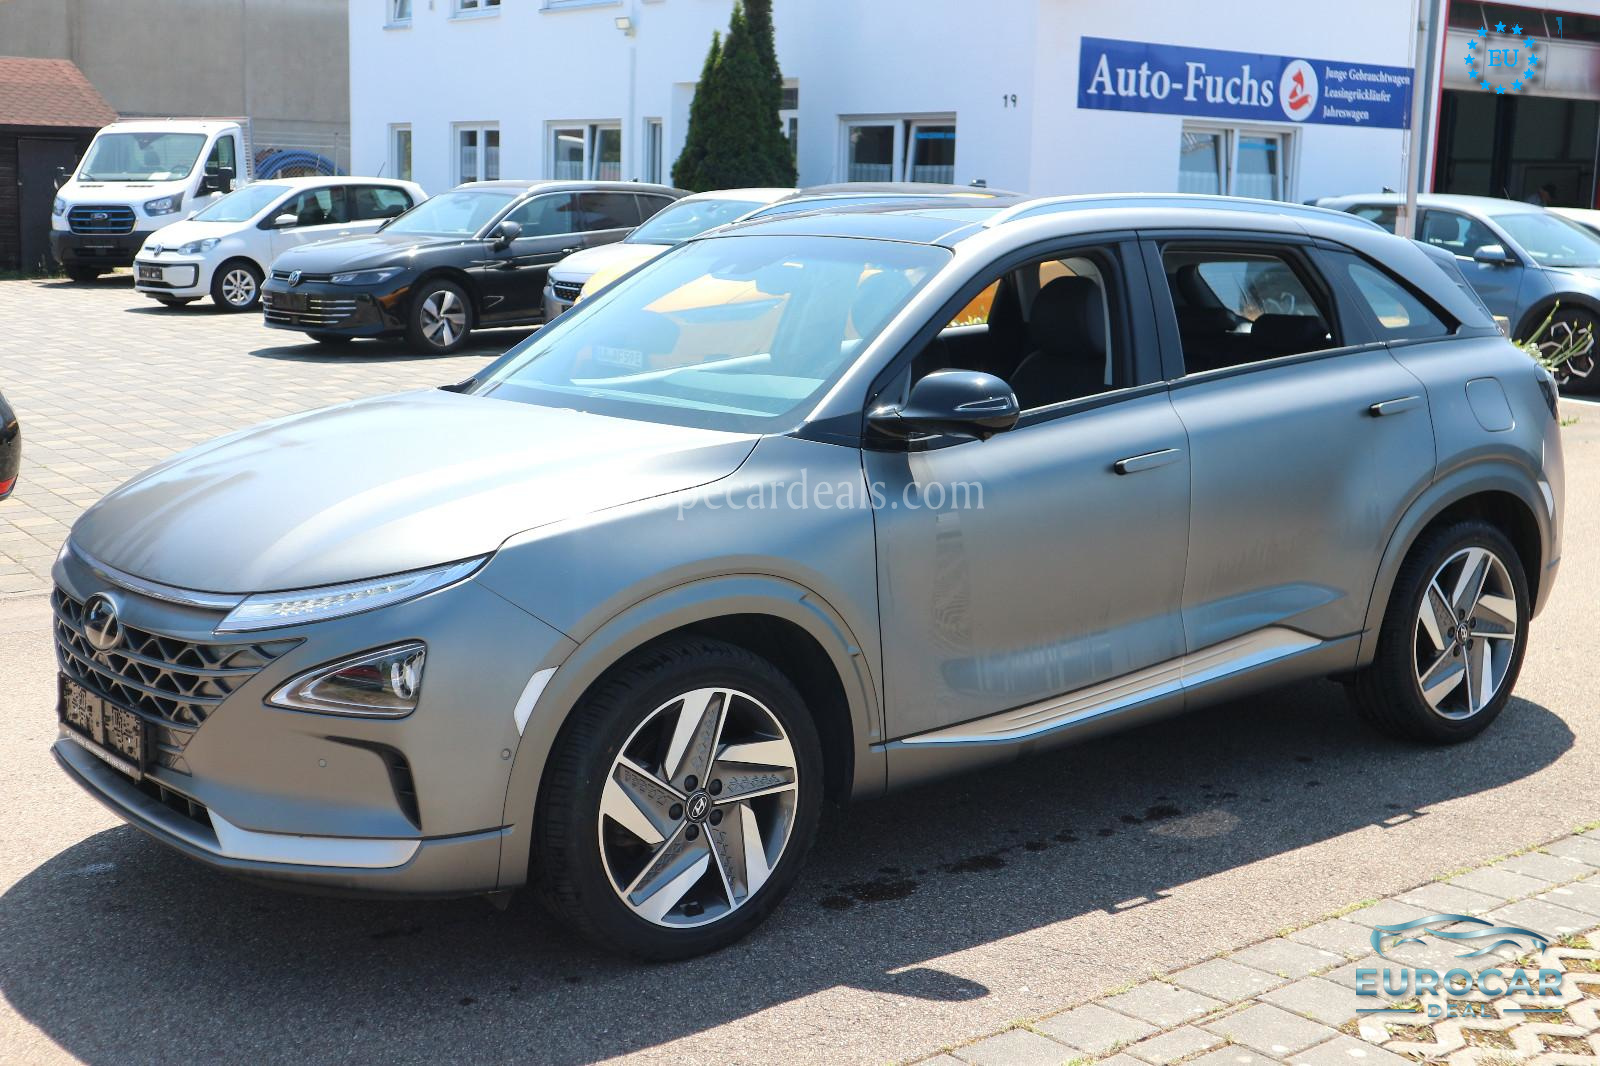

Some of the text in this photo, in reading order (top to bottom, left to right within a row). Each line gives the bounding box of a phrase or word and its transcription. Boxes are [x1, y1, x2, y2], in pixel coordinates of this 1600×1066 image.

[1087, 54, 1274, 107] Auto-Fuchs
[1326, 66, 1410, 88] Junge Gebrauchtwagen
[1002, 94, 1017, 108] 19
[1325, 86, 1391, 103] Leasingrückläufer
[1323, 105, 1369, 122] Jahreswagen
